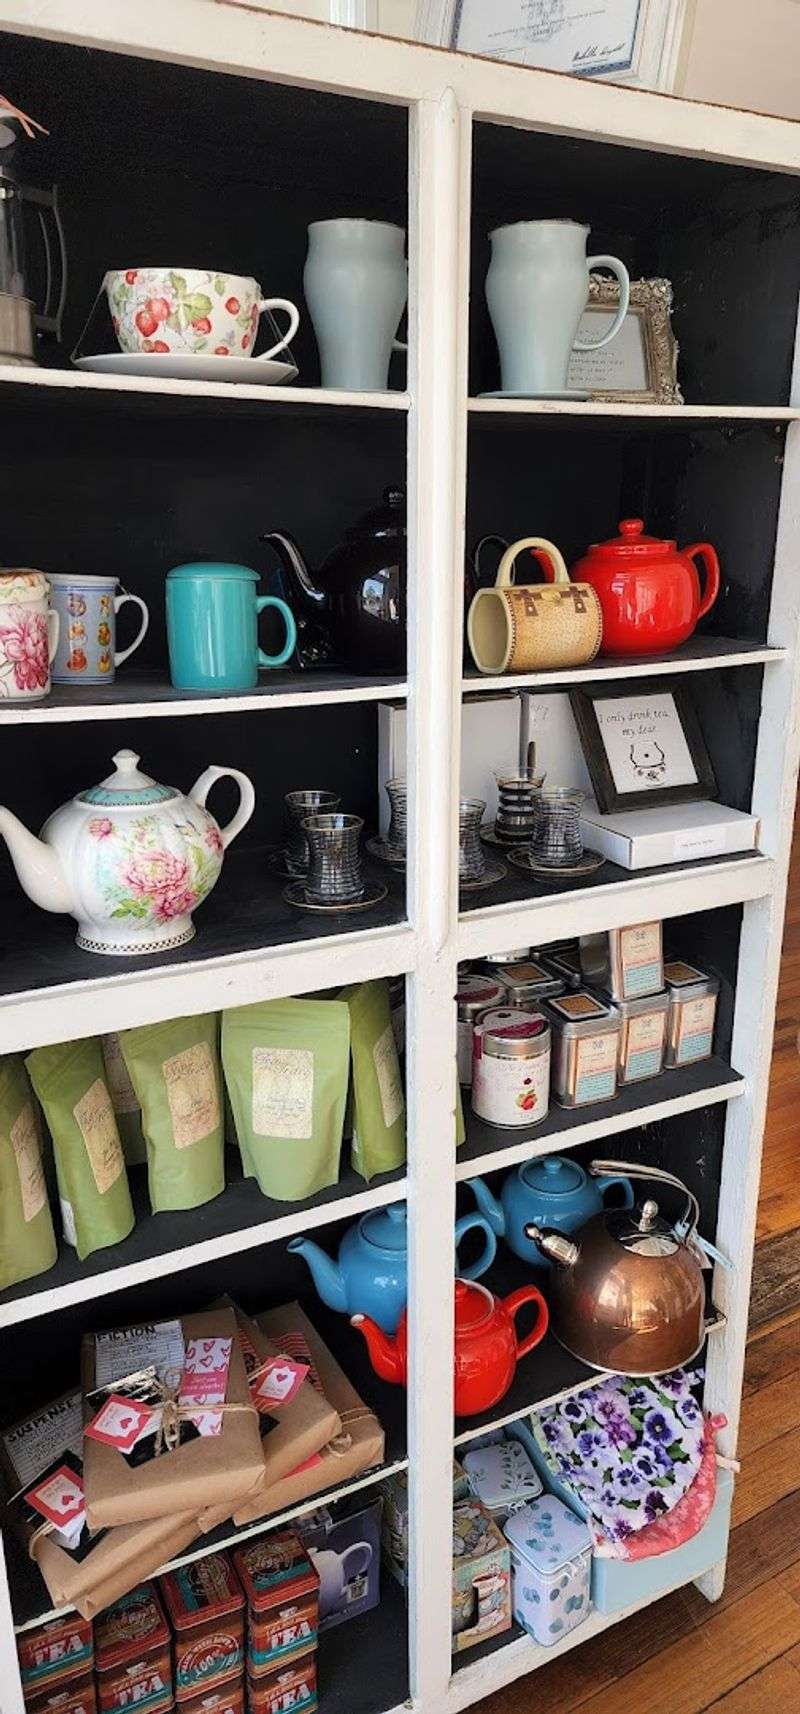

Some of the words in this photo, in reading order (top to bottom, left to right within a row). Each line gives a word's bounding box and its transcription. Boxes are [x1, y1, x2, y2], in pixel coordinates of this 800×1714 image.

[607, 711, 625, 723] only
[629, 708, 651, 720] drink
[653, 709, 669, 718] tea
[622, 728, 635, 738] my
[638, 725, 656, 735] dear
[97, 1325, 156, 1341] FICTION
[8, 1400, 74, 1442] SUSPENSE
[31, 1634, 83, 1666] TEA
[266, 1621, 311, 1650] TEA
[113, 1676, 164, 1707] TEA
[266, 1683, 311, 1714] TEA
